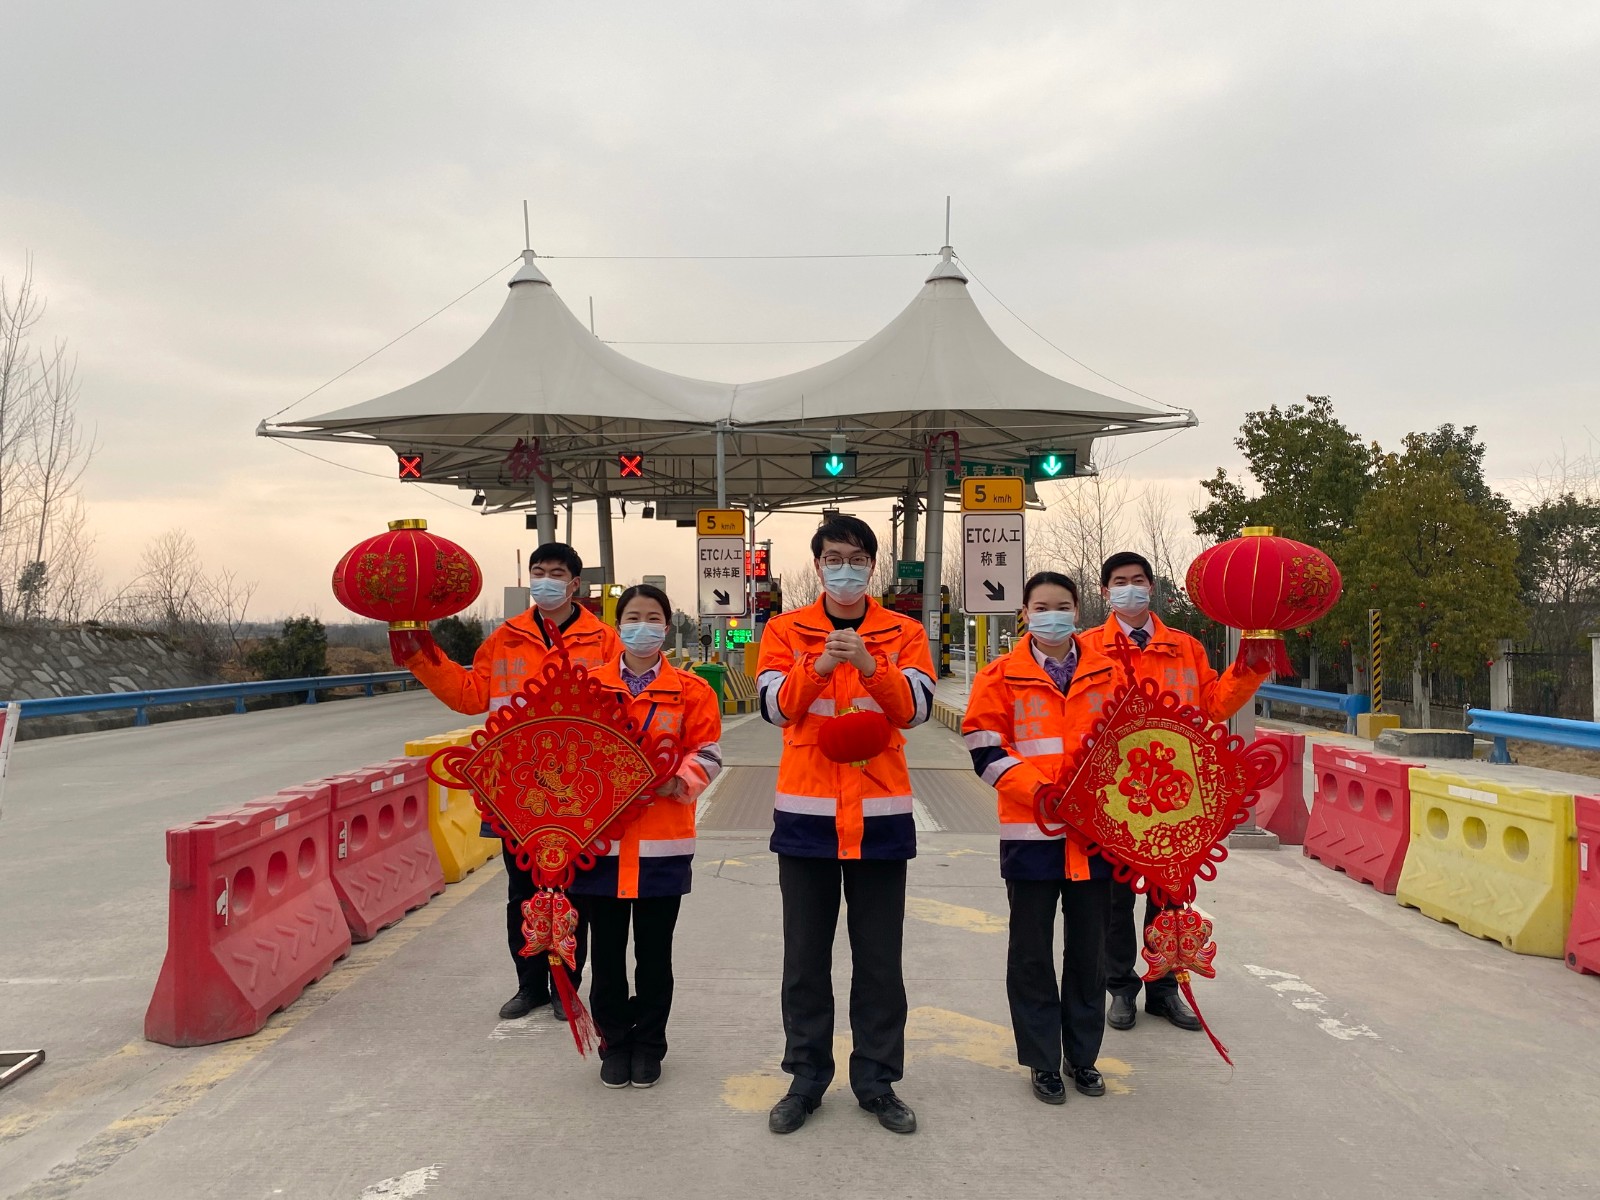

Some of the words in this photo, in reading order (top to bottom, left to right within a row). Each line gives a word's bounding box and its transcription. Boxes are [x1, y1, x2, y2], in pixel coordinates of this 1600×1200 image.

[974, 485, 987, 503] 5
[993, 494, 1012, 503] km/h
[706, 516, 716, 530] 5
[966, 528, 1021, 543] ETC/人工
[700, 549, 743, 560] ETC/人工
[980, 551, 1007, 566] 称重
[703, 567, 741, 579] 保持车距
